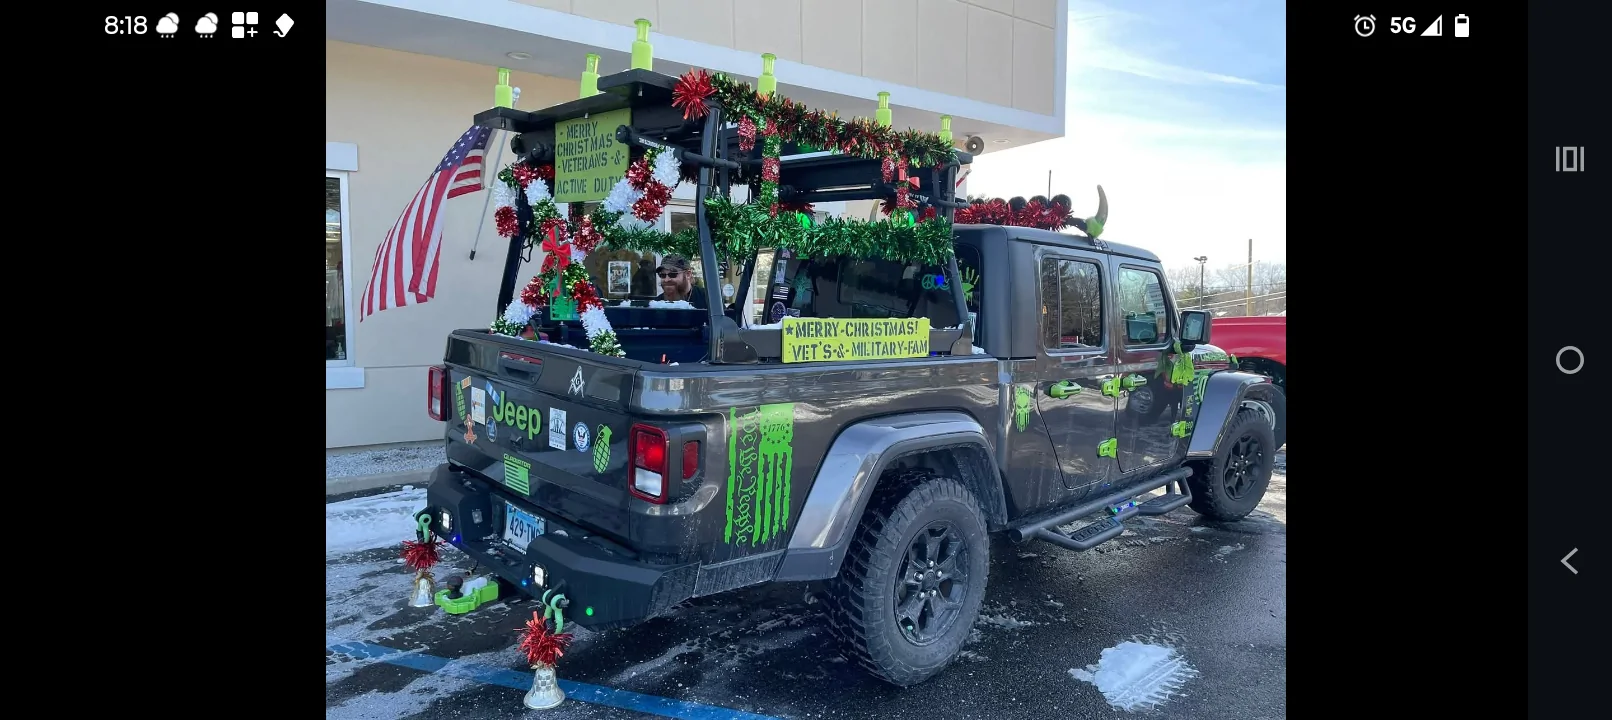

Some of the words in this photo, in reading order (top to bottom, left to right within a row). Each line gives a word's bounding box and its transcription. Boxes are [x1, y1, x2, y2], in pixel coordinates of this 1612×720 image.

[557, 133, 613, 157] CHRISTMAS
[557, 179, 587, 195] ACTIVE
[492, 390, 543, 440] Jeep
[767, 423, 785, 433] 1776
[733, 475, 757, 547] People
